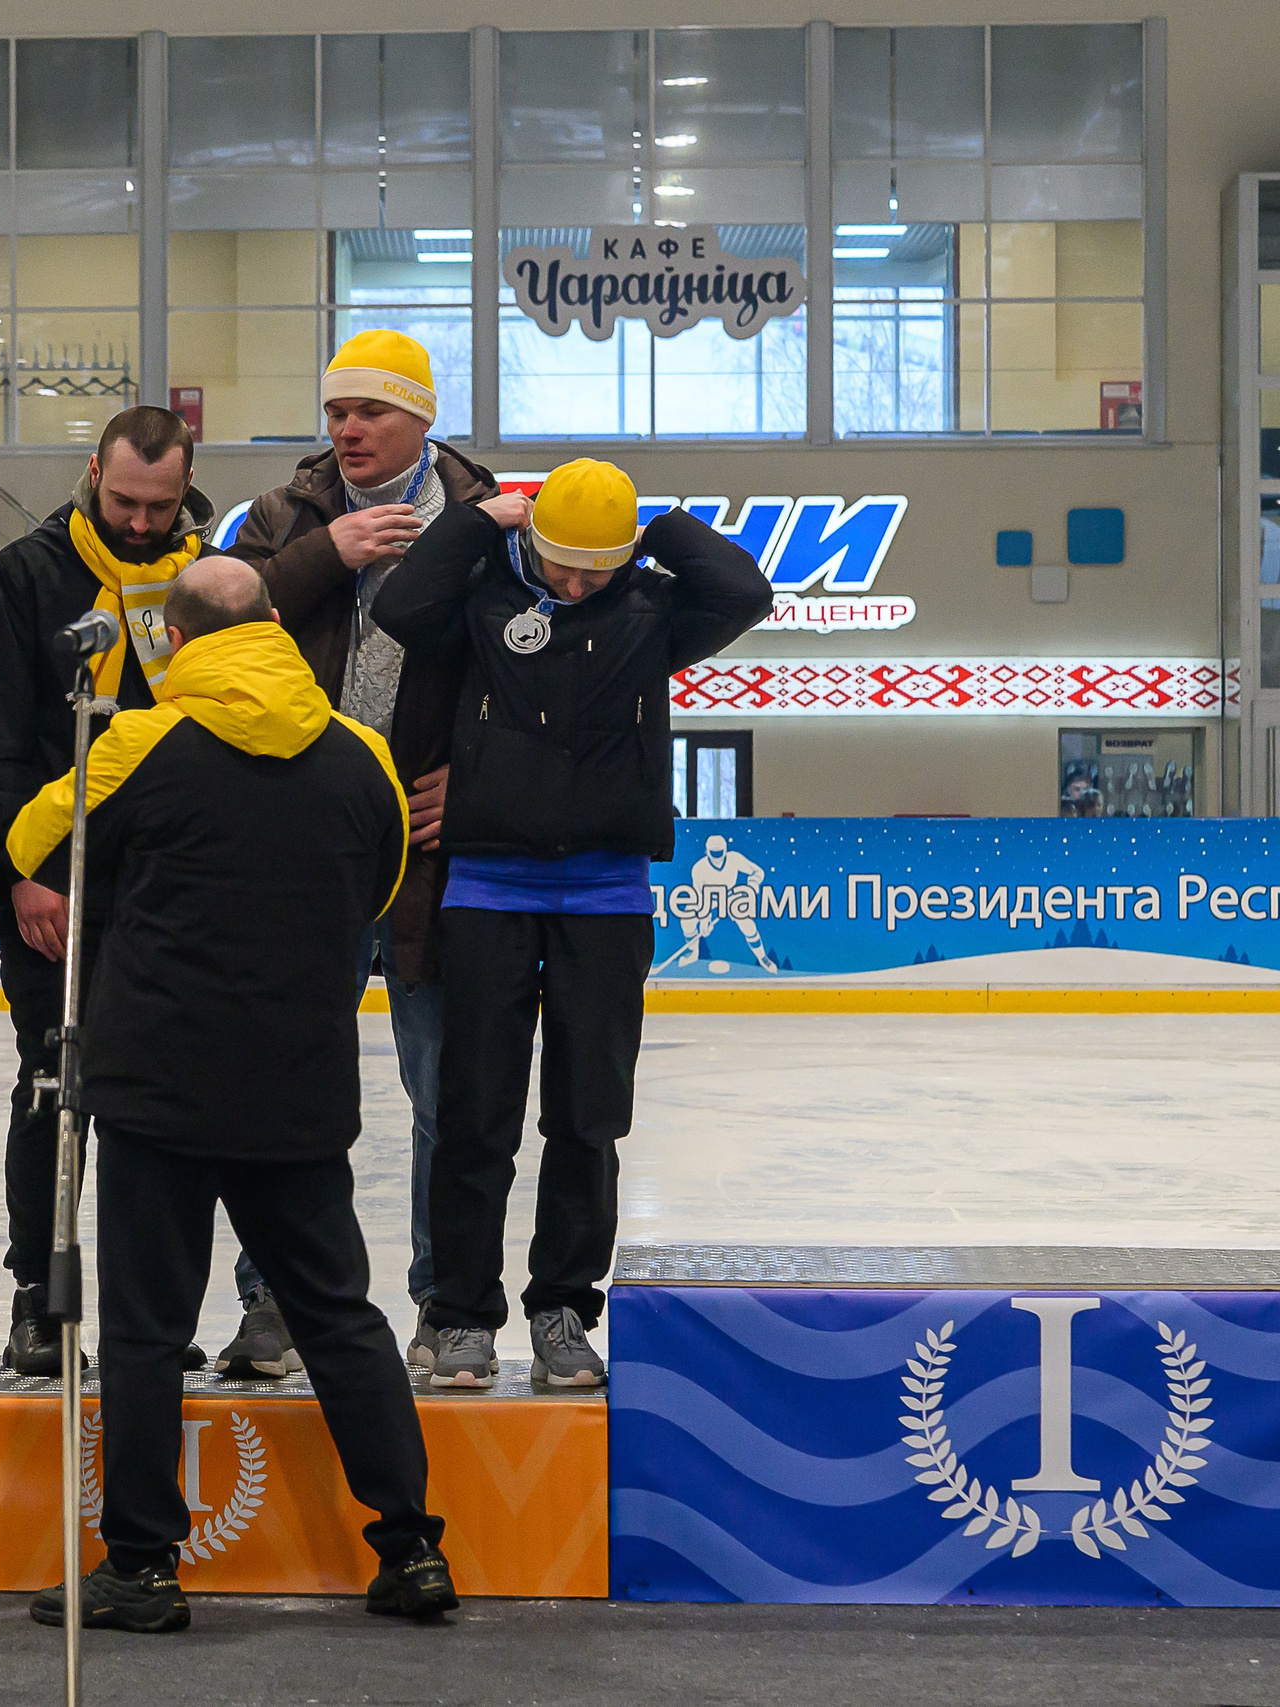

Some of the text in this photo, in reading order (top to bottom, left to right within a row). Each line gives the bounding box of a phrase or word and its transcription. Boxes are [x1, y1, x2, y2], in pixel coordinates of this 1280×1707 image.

[604, 238, 706, 260] КАФЕ
[516, 259, 794, 329] Чараўніца
[806, 605, 908, 625] ЦЕНТР
[847, 874, 1161, 931] Президента
[1011, 1297, 1101, 1492] I
